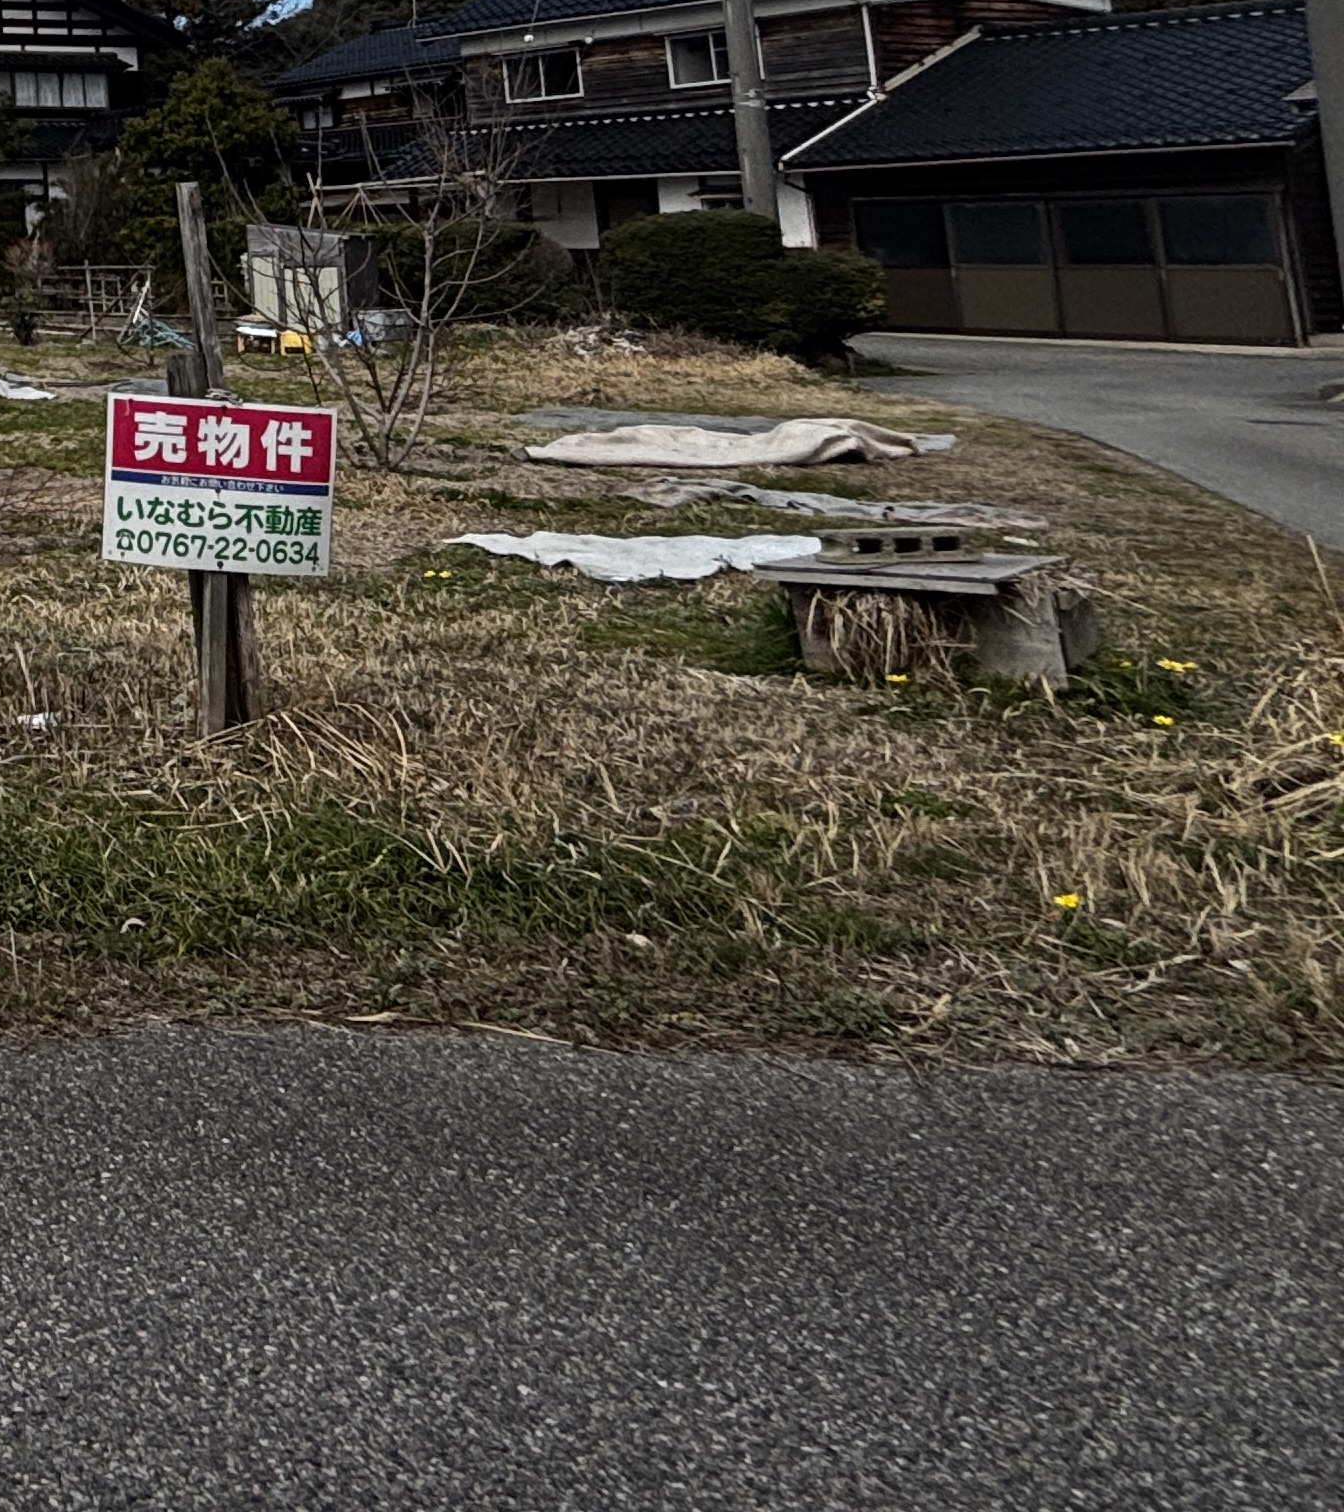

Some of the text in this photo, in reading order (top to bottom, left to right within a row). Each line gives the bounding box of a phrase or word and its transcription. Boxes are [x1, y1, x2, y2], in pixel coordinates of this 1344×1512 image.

[134, 412, 313, 473] 売物件
[117, 496, 322, 536] いなむら不動産
